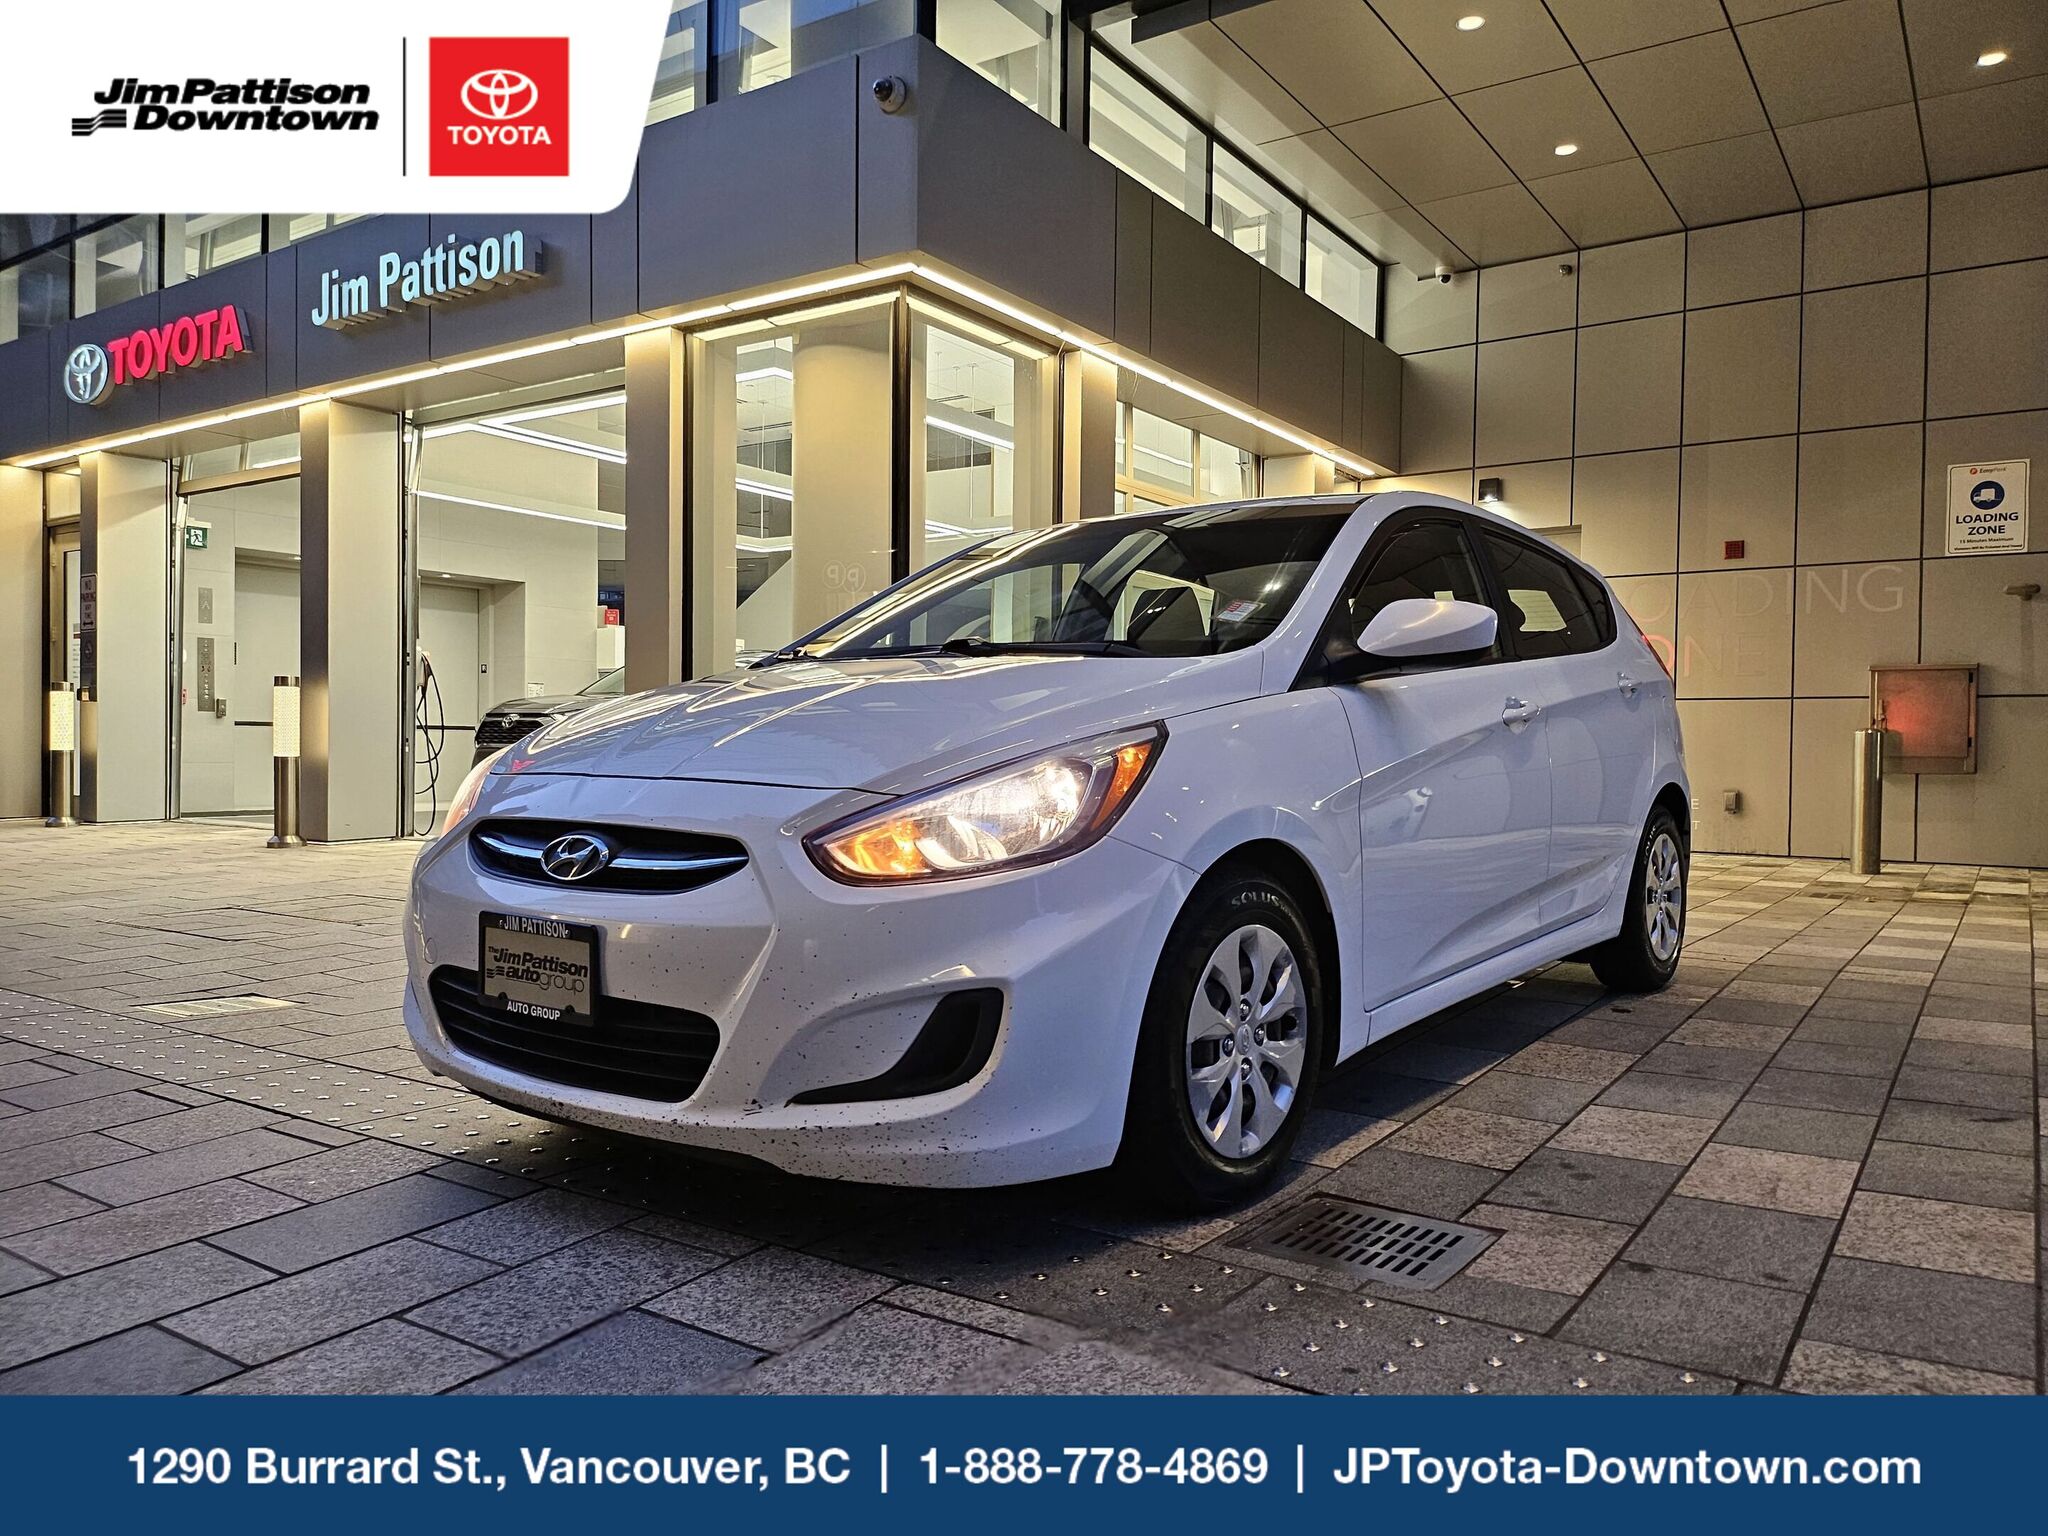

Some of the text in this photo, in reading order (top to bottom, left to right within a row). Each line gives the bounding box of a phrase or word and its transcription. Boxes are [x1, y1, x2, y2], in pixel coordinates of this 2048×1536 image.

[311, 228, 525, 327] Jim Pattison
[107, 304, 244, 385] TOYOTA
[1955, 511, 2019, 525] LOADING
[1967, 524, 2006, 536] ZONE
[1628, 564, 1905, 623] OADING
[504, 915, 566, 938] JIM PATTISON
[507, 1000, 560, 1021] AUTO GROUP
